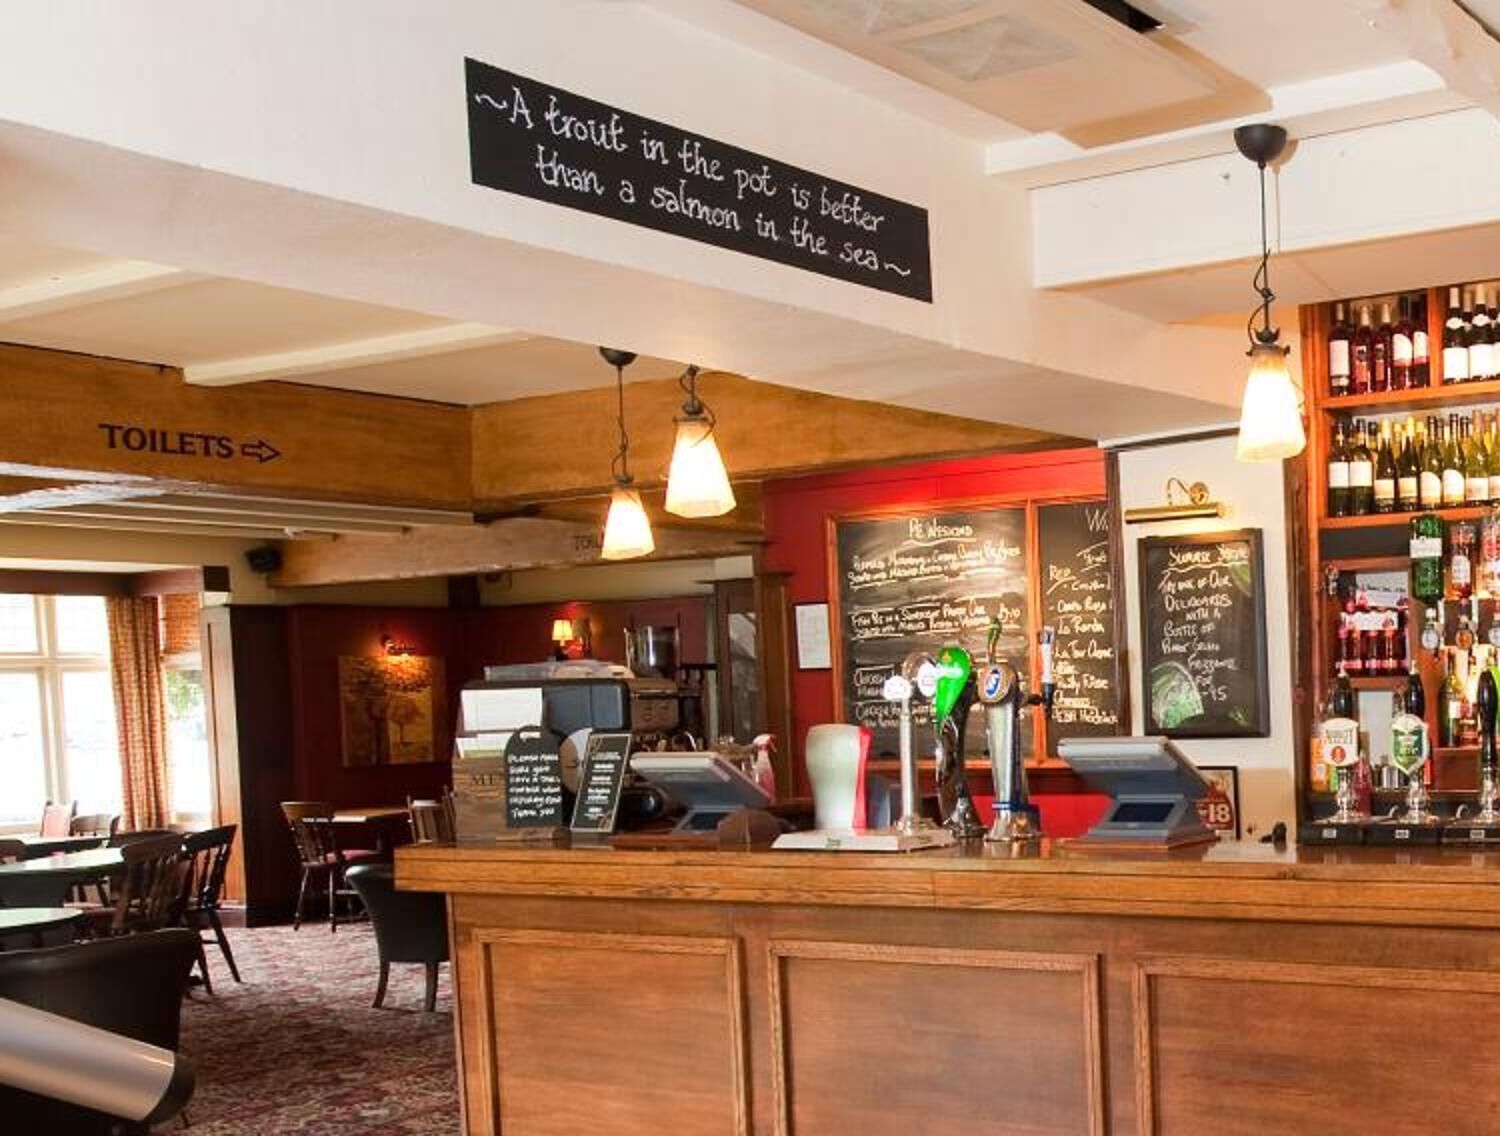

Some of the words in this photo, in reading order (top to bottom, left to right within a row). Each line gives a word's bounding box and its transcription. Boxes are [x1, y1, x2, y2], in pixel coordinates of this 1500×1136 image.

[534, 145, 605, 196] than
[619, 178, 636, 203] a
[650, 179, 741, 232] salmon
[756, 212, 778, 241] in
[790, 220, 829, 255] the
[839, 243, 881, 270] sea
[545, 97, 628, 152] trout
[641, 131, 668, 164] in
[678, 140, 724, 181] the
[735, 165, 777, 200] pot
[791, 183, 810, 211] is
[820, 186, 886, 232] better
[98, 423, 234, 459] TOILETS
